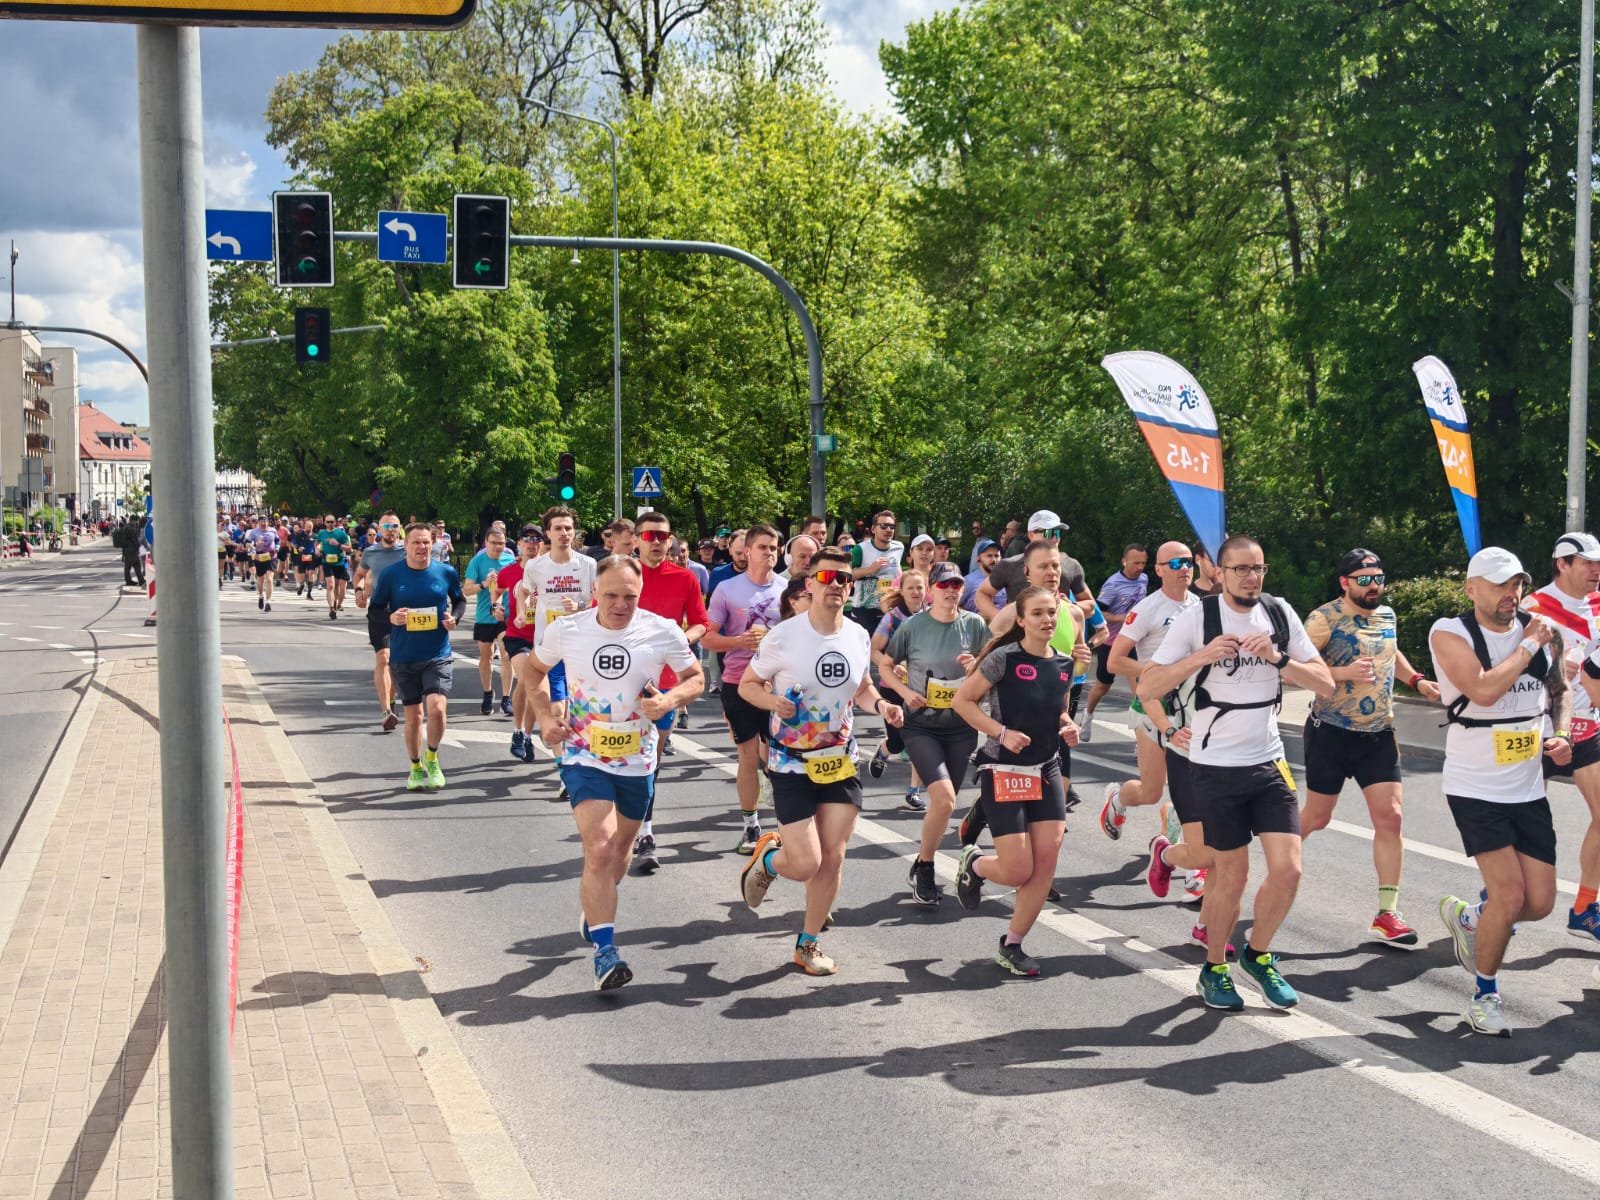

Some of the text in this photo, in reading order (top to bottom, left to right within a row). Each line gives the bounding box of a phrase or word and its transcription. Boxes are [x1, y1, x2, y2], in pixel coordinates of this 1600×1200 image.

[412, 616, 431, 624] 1531
[600, 734, 632, 746] 2002
[814, 758, 842, 774] 2023
[1005, 777, 1032, 789] 1018
